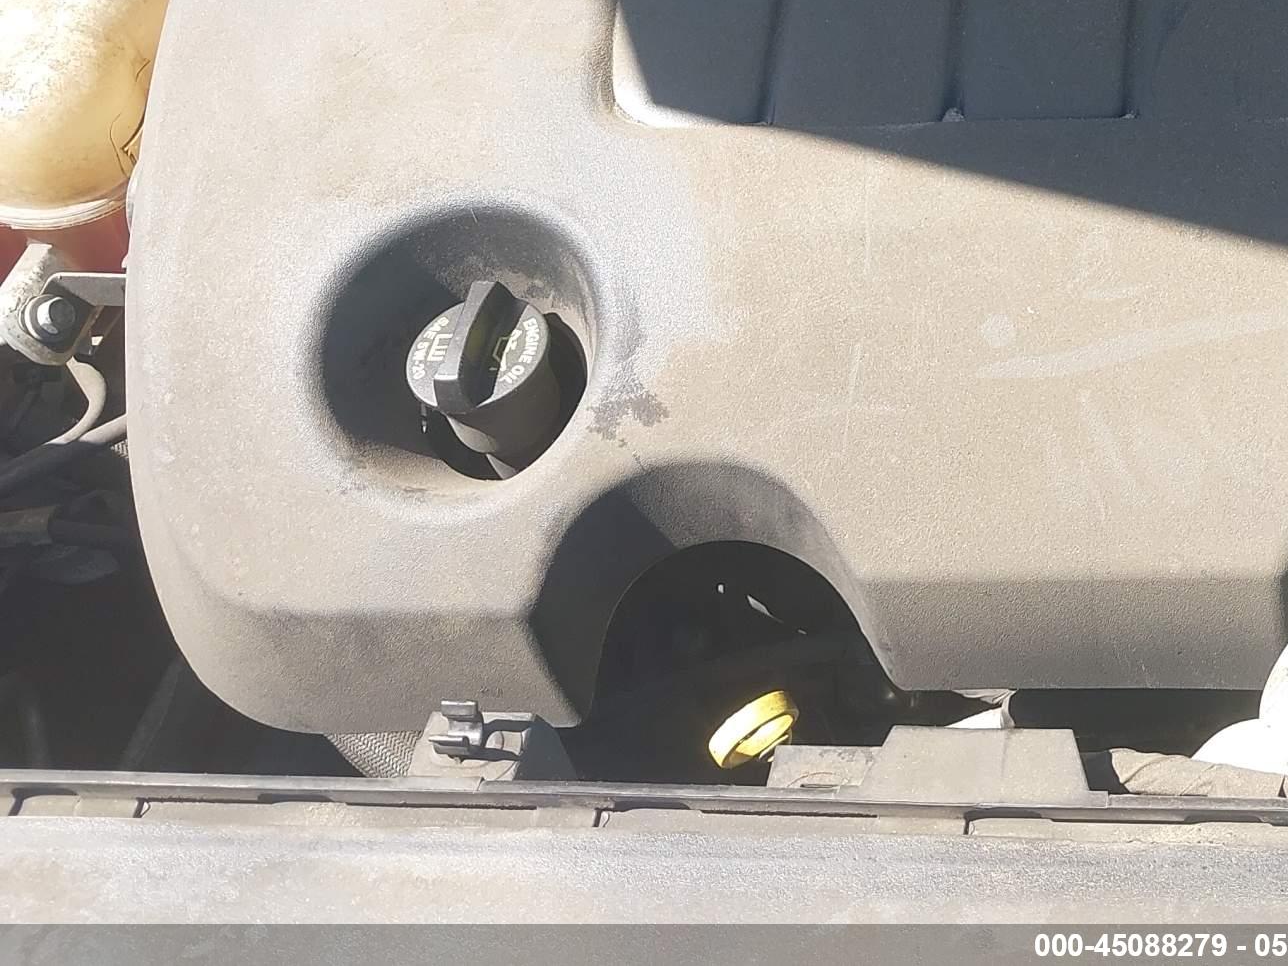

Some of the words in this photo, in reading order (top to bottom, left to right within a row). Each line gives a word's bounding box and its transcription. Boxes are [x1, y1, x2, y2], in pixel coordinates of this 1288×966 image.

[424, 316, 449, 339] SAE
[519, 317, 540, 365] ENGINE
[411, 342, 430, 380] 5W-20
[499, 365, 525, 384] OIL
